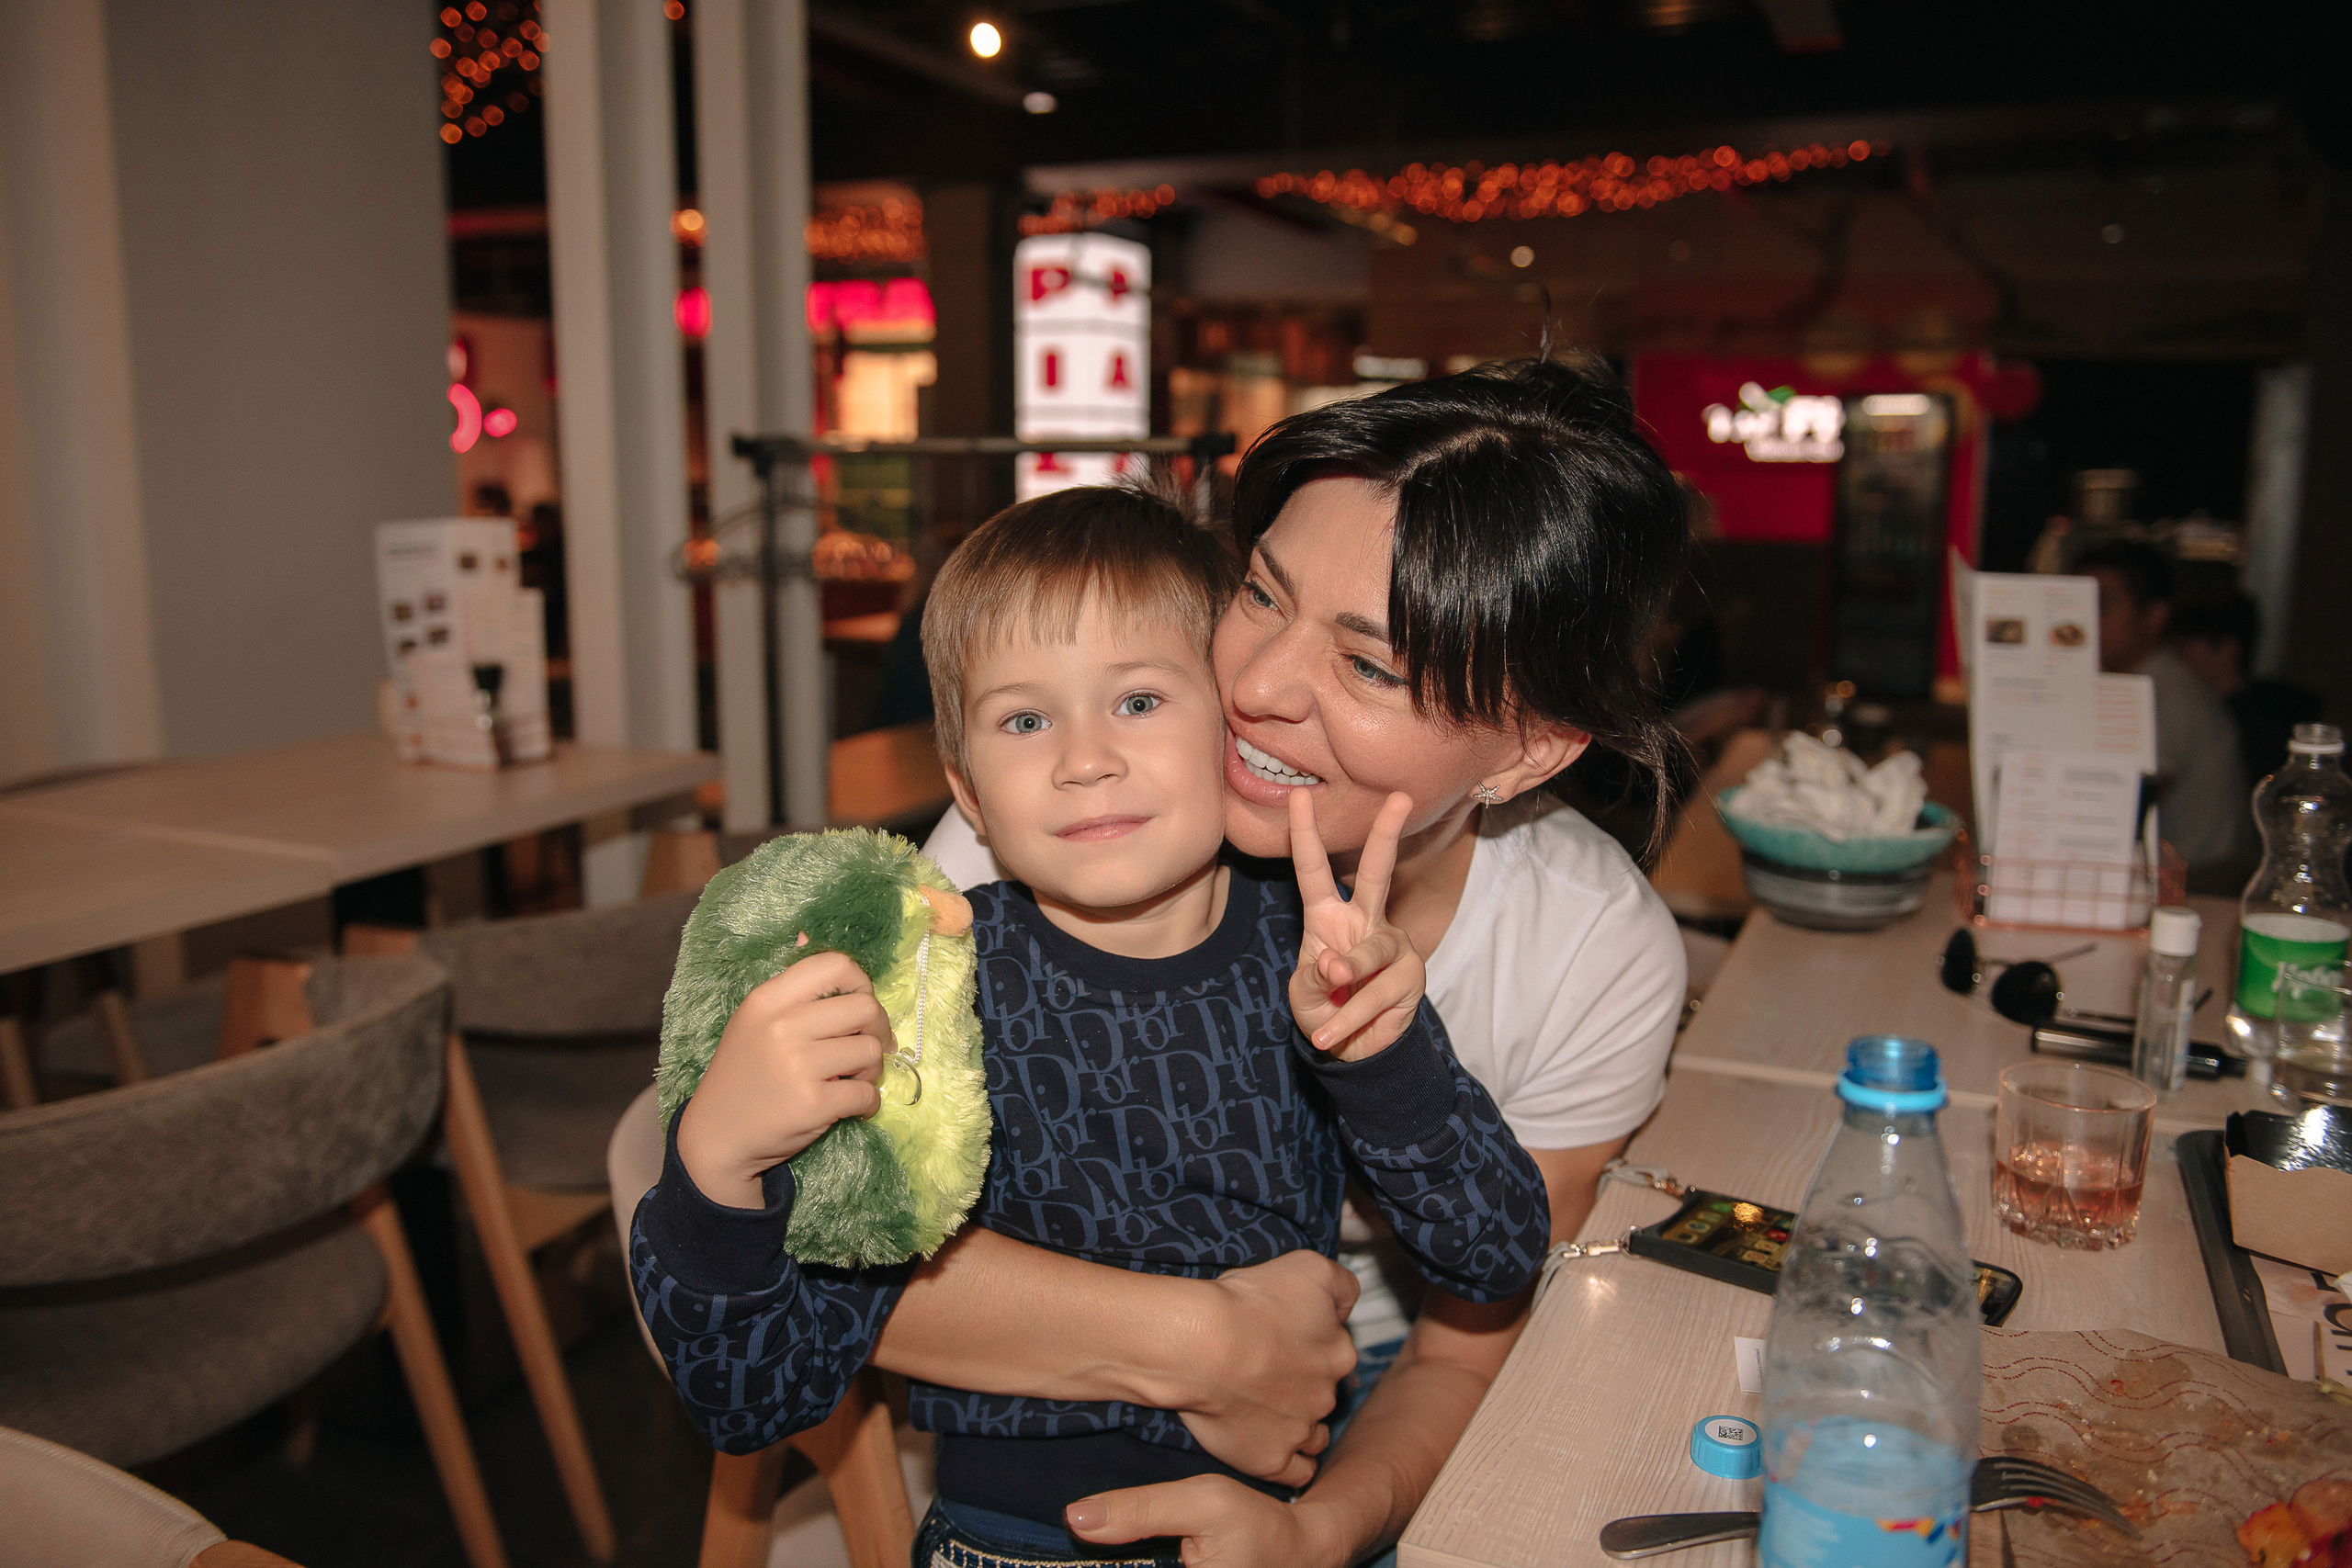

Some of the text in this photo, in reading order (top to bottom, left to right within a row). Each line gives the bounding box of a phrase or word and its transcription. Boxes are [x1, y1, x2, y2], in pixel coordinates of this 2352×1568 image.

[1004, 1054, 1097, 1156] Dior
[1050, 1009, 1140, 1103] Dior
[1141, 1050, 1237, 1149] Dior
[1098, 1104, 1195, 1201] Dior
